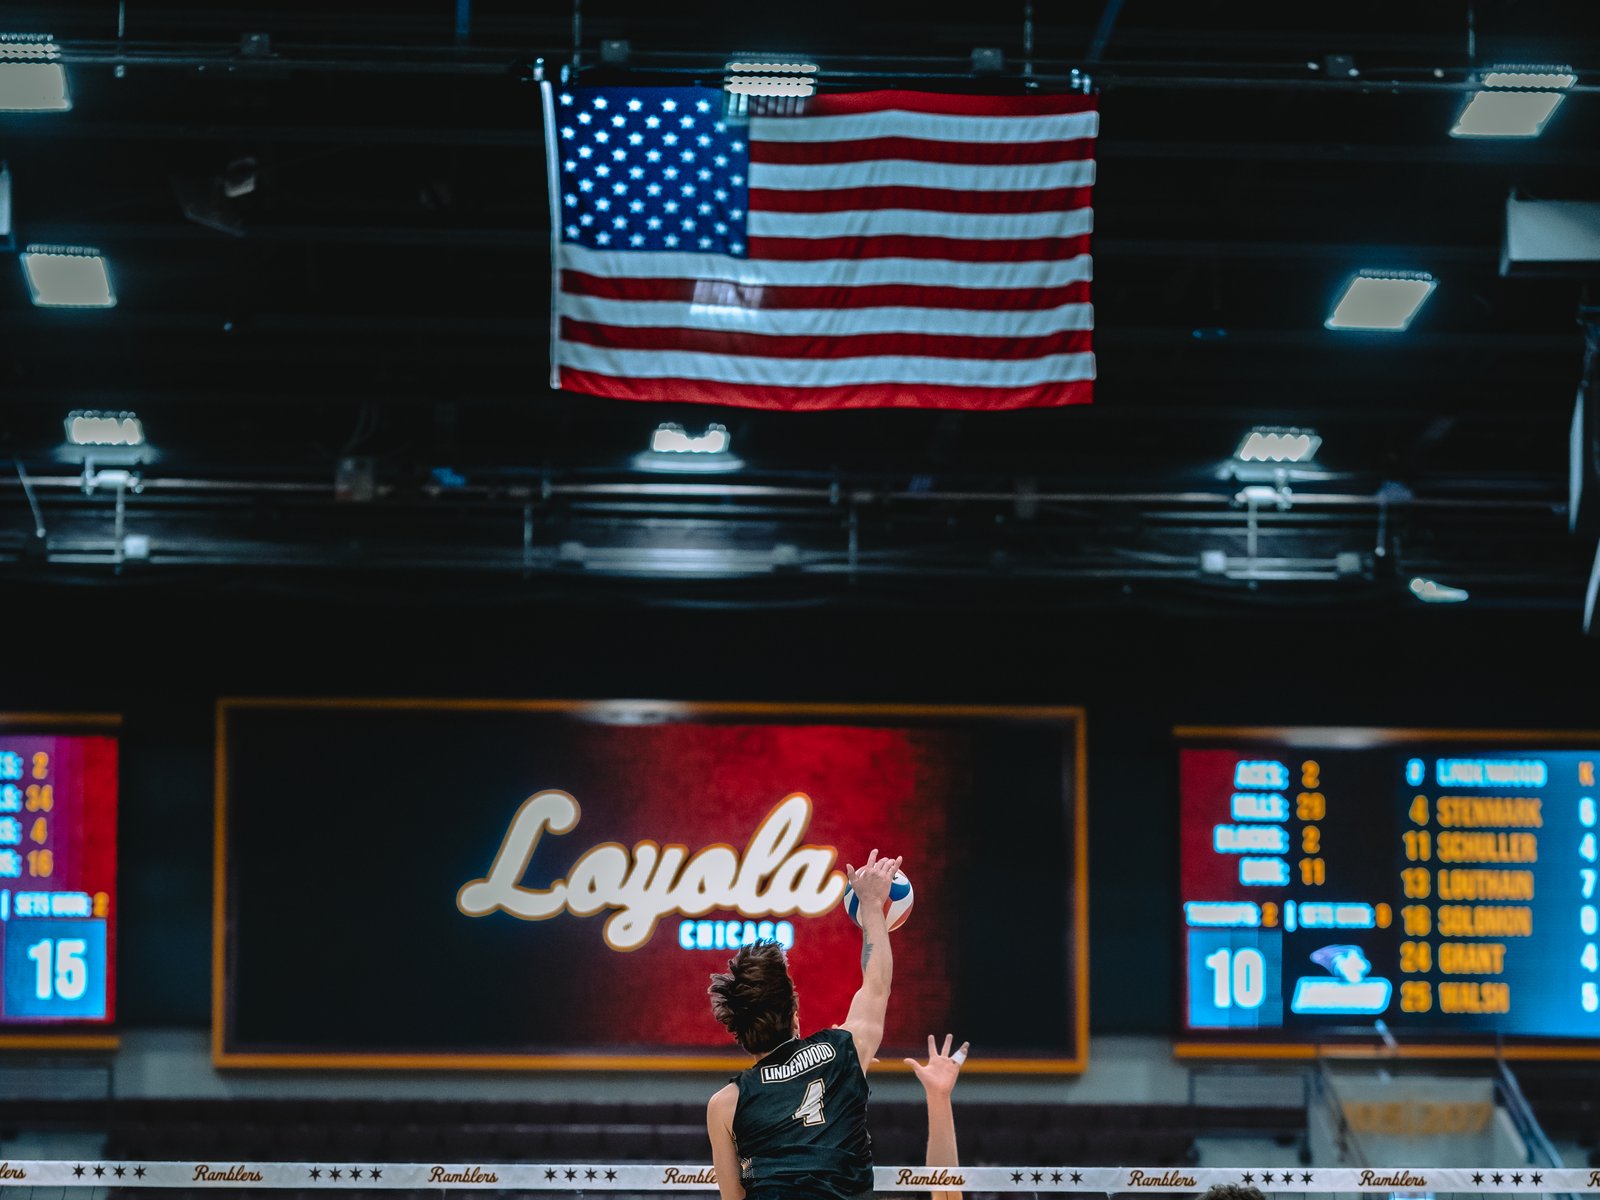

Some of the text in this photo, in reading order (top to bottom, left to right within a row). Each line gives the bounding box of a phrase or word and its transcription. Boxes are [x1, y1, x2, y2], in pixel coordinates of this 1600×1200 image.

[1408, 794, 1429, 826] 4
[1402, 830, 1431, 862] 11
[456, 789, 846, 952] Loyola
[1299, 857, 1326, 886] 11
[1579, 868, 1598, 899] 7
[679, 920, 794, 950] CHICAGO
[29, 938, 86, 1000] 15
[1206, 948, 1266, 1009] 10
[763, 1043, 835, 1083] LINDENWOOD
[792, 1078, 826, 1127] 4
[192, 1164, 263, 1182] Ramblers
[427, 1166, 499, 1184] Ramblers
[662, 1167, 717, 1185] Ramble
[896, 1169, 966, 1186] Ramblers
[1127, 1170, 1197, 1188] Ramblers
[1358, 1170, 1427, 1188] Ramblers
